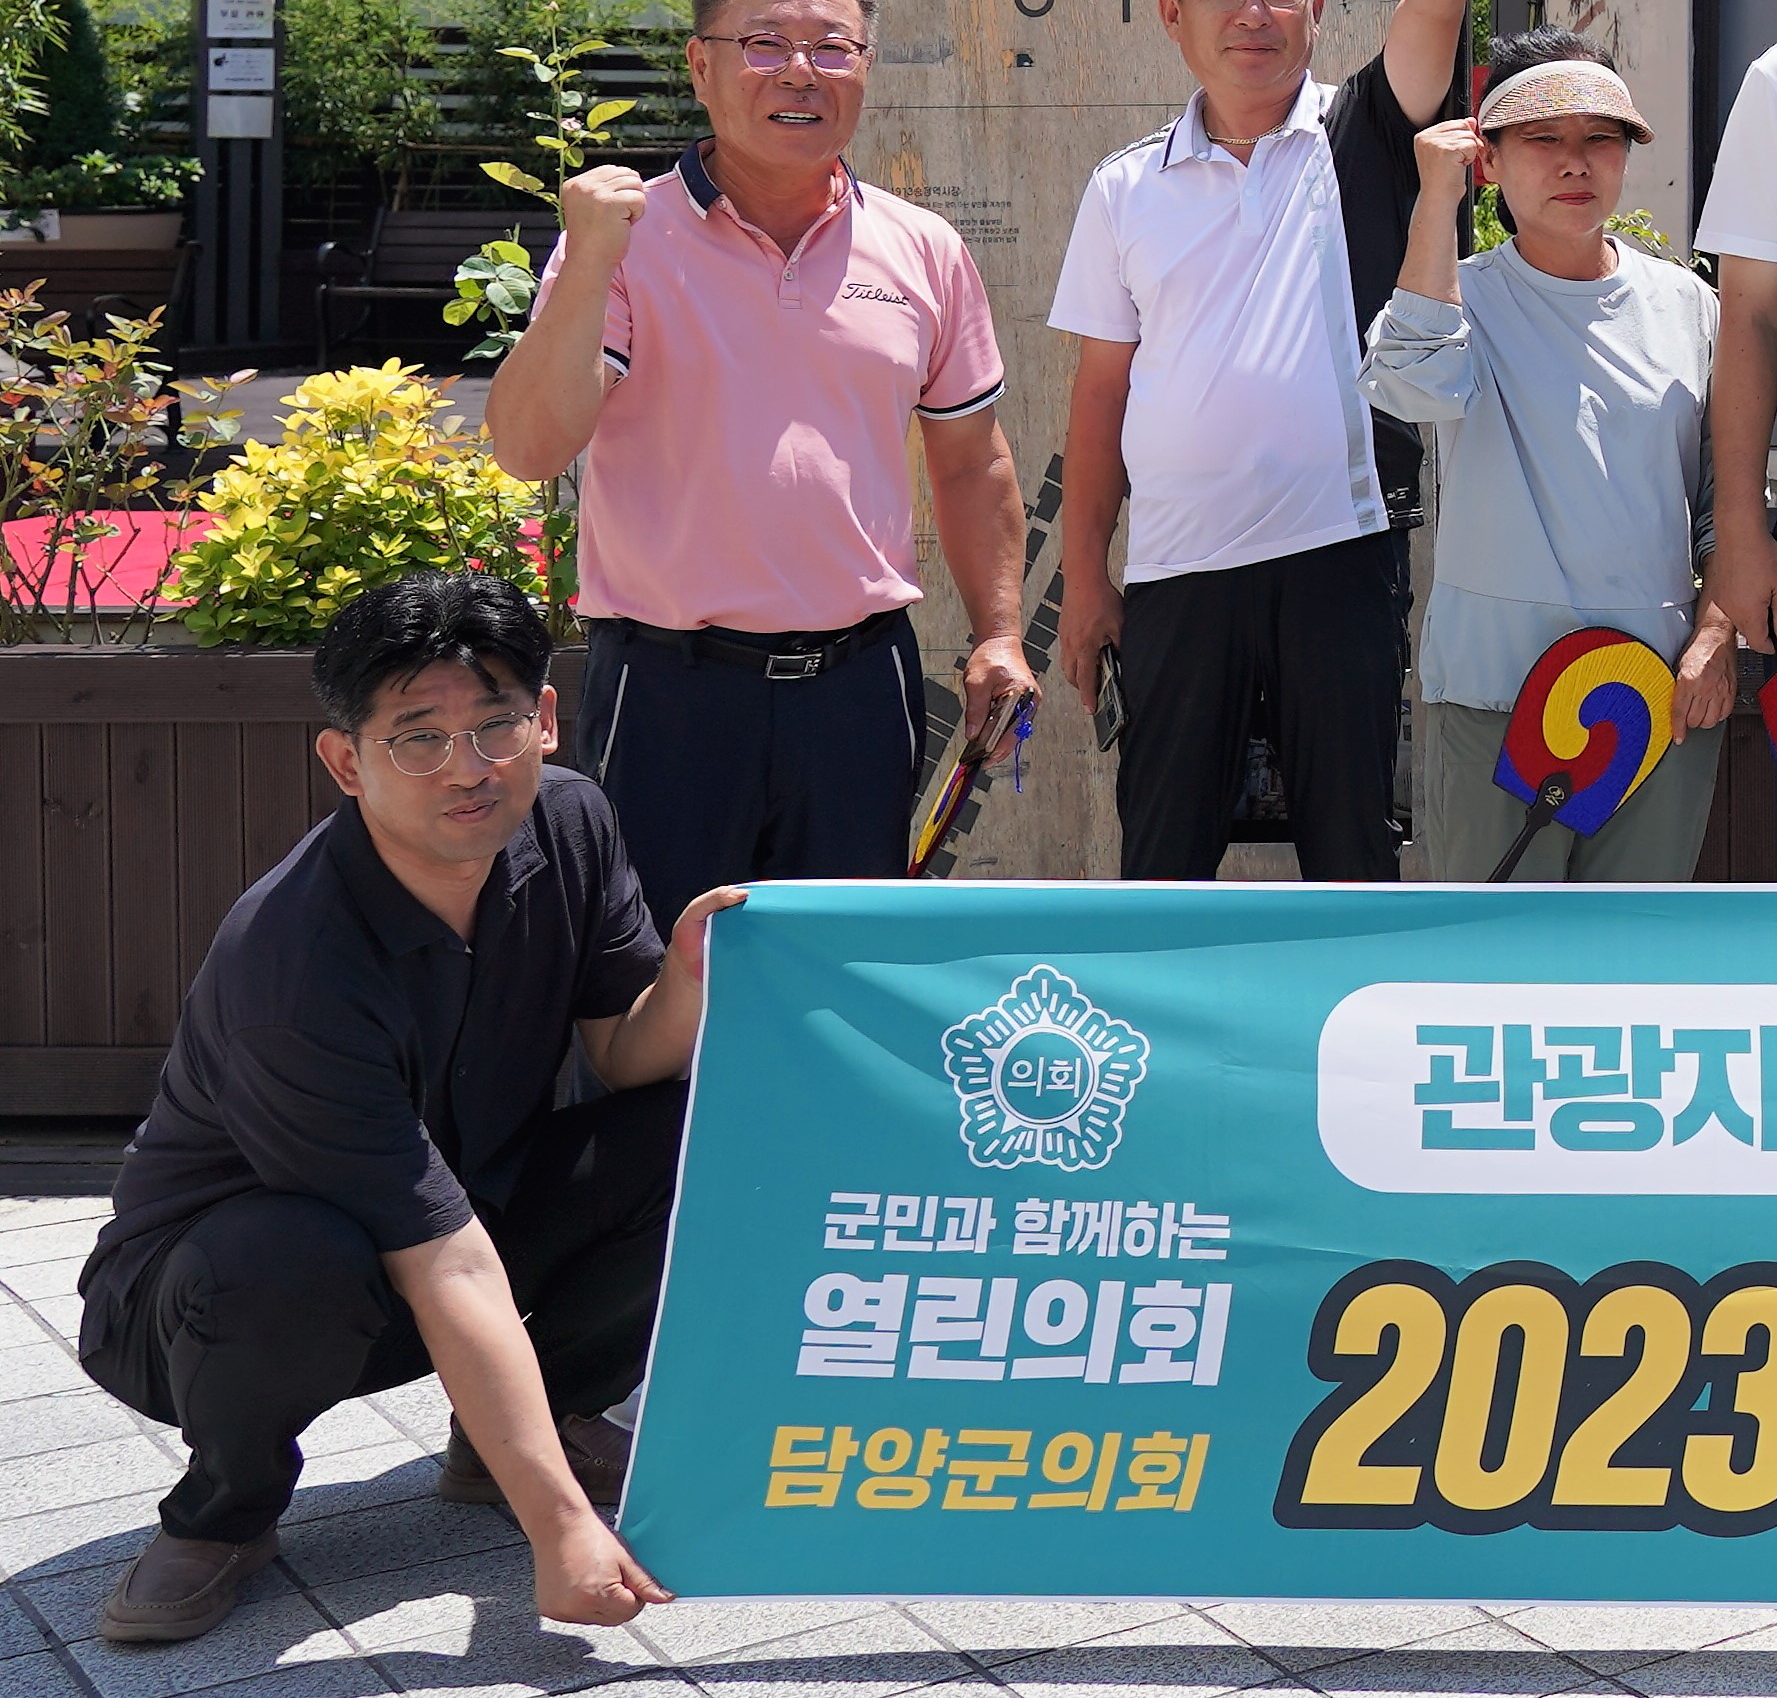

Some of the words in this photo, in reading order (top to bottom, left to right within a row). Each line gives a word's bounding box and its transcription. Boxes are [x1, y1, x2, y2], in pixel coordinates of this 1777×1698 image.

[841, 283, 910, 305] Titleist
[1006, 1055, 1083, 1098] 의회
[823, 1191, 997, 1255] 군민과
[1012, 1196, 1231, 1261] 함께하는
[795, 1270, 1233, 1387] 열린의회
[763, 1425, 1211, 1513] 담양군의회
